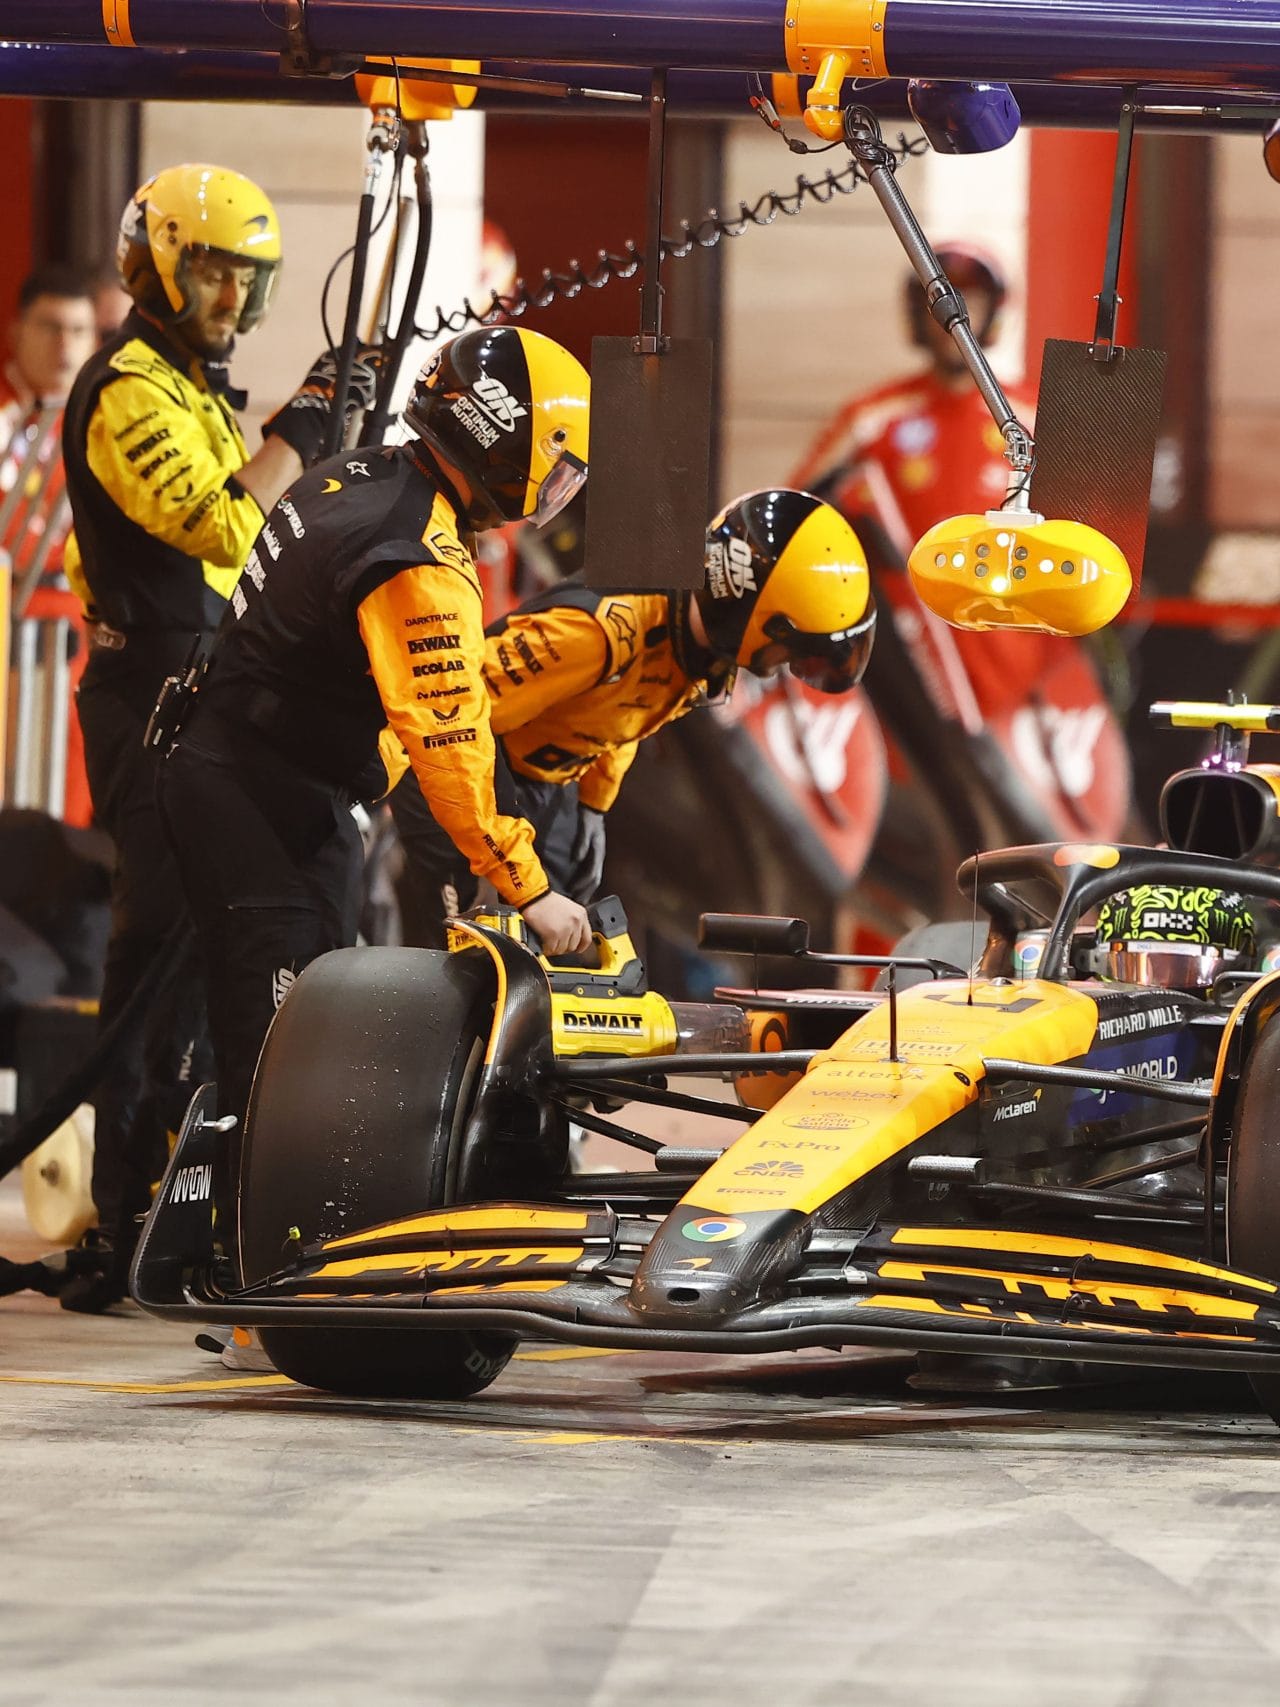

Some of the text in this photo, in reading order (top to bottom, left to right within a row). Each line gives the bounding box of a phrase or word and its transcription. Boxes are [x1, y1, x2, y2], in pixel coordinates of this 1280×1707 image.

[473, 377, 528, 433] ON
[449, 402, 492, 450] NUTRITION
[457, 396, 501, 444] OPTIMUM
[723, 537, 757, 599] ON
[405, 612, 459, 627] DARKTRACE
[412, 660, 465, 678] ECOLAB
[423, 728, 477, 749] PIRELLI
[1143, 912, 1194, 931] OKX
[1099, 1005, 1183, 1040] RICHARD MILLE
[827, 1069, 924, 1081] alteryx
[1124, 1056, 1179, 1081] WORLD
[993, 1099, 1037, 1123] McLaren
[757, 1140, 841, 1152] FxPro
[734, 1170, 805, 1178] CNBC
